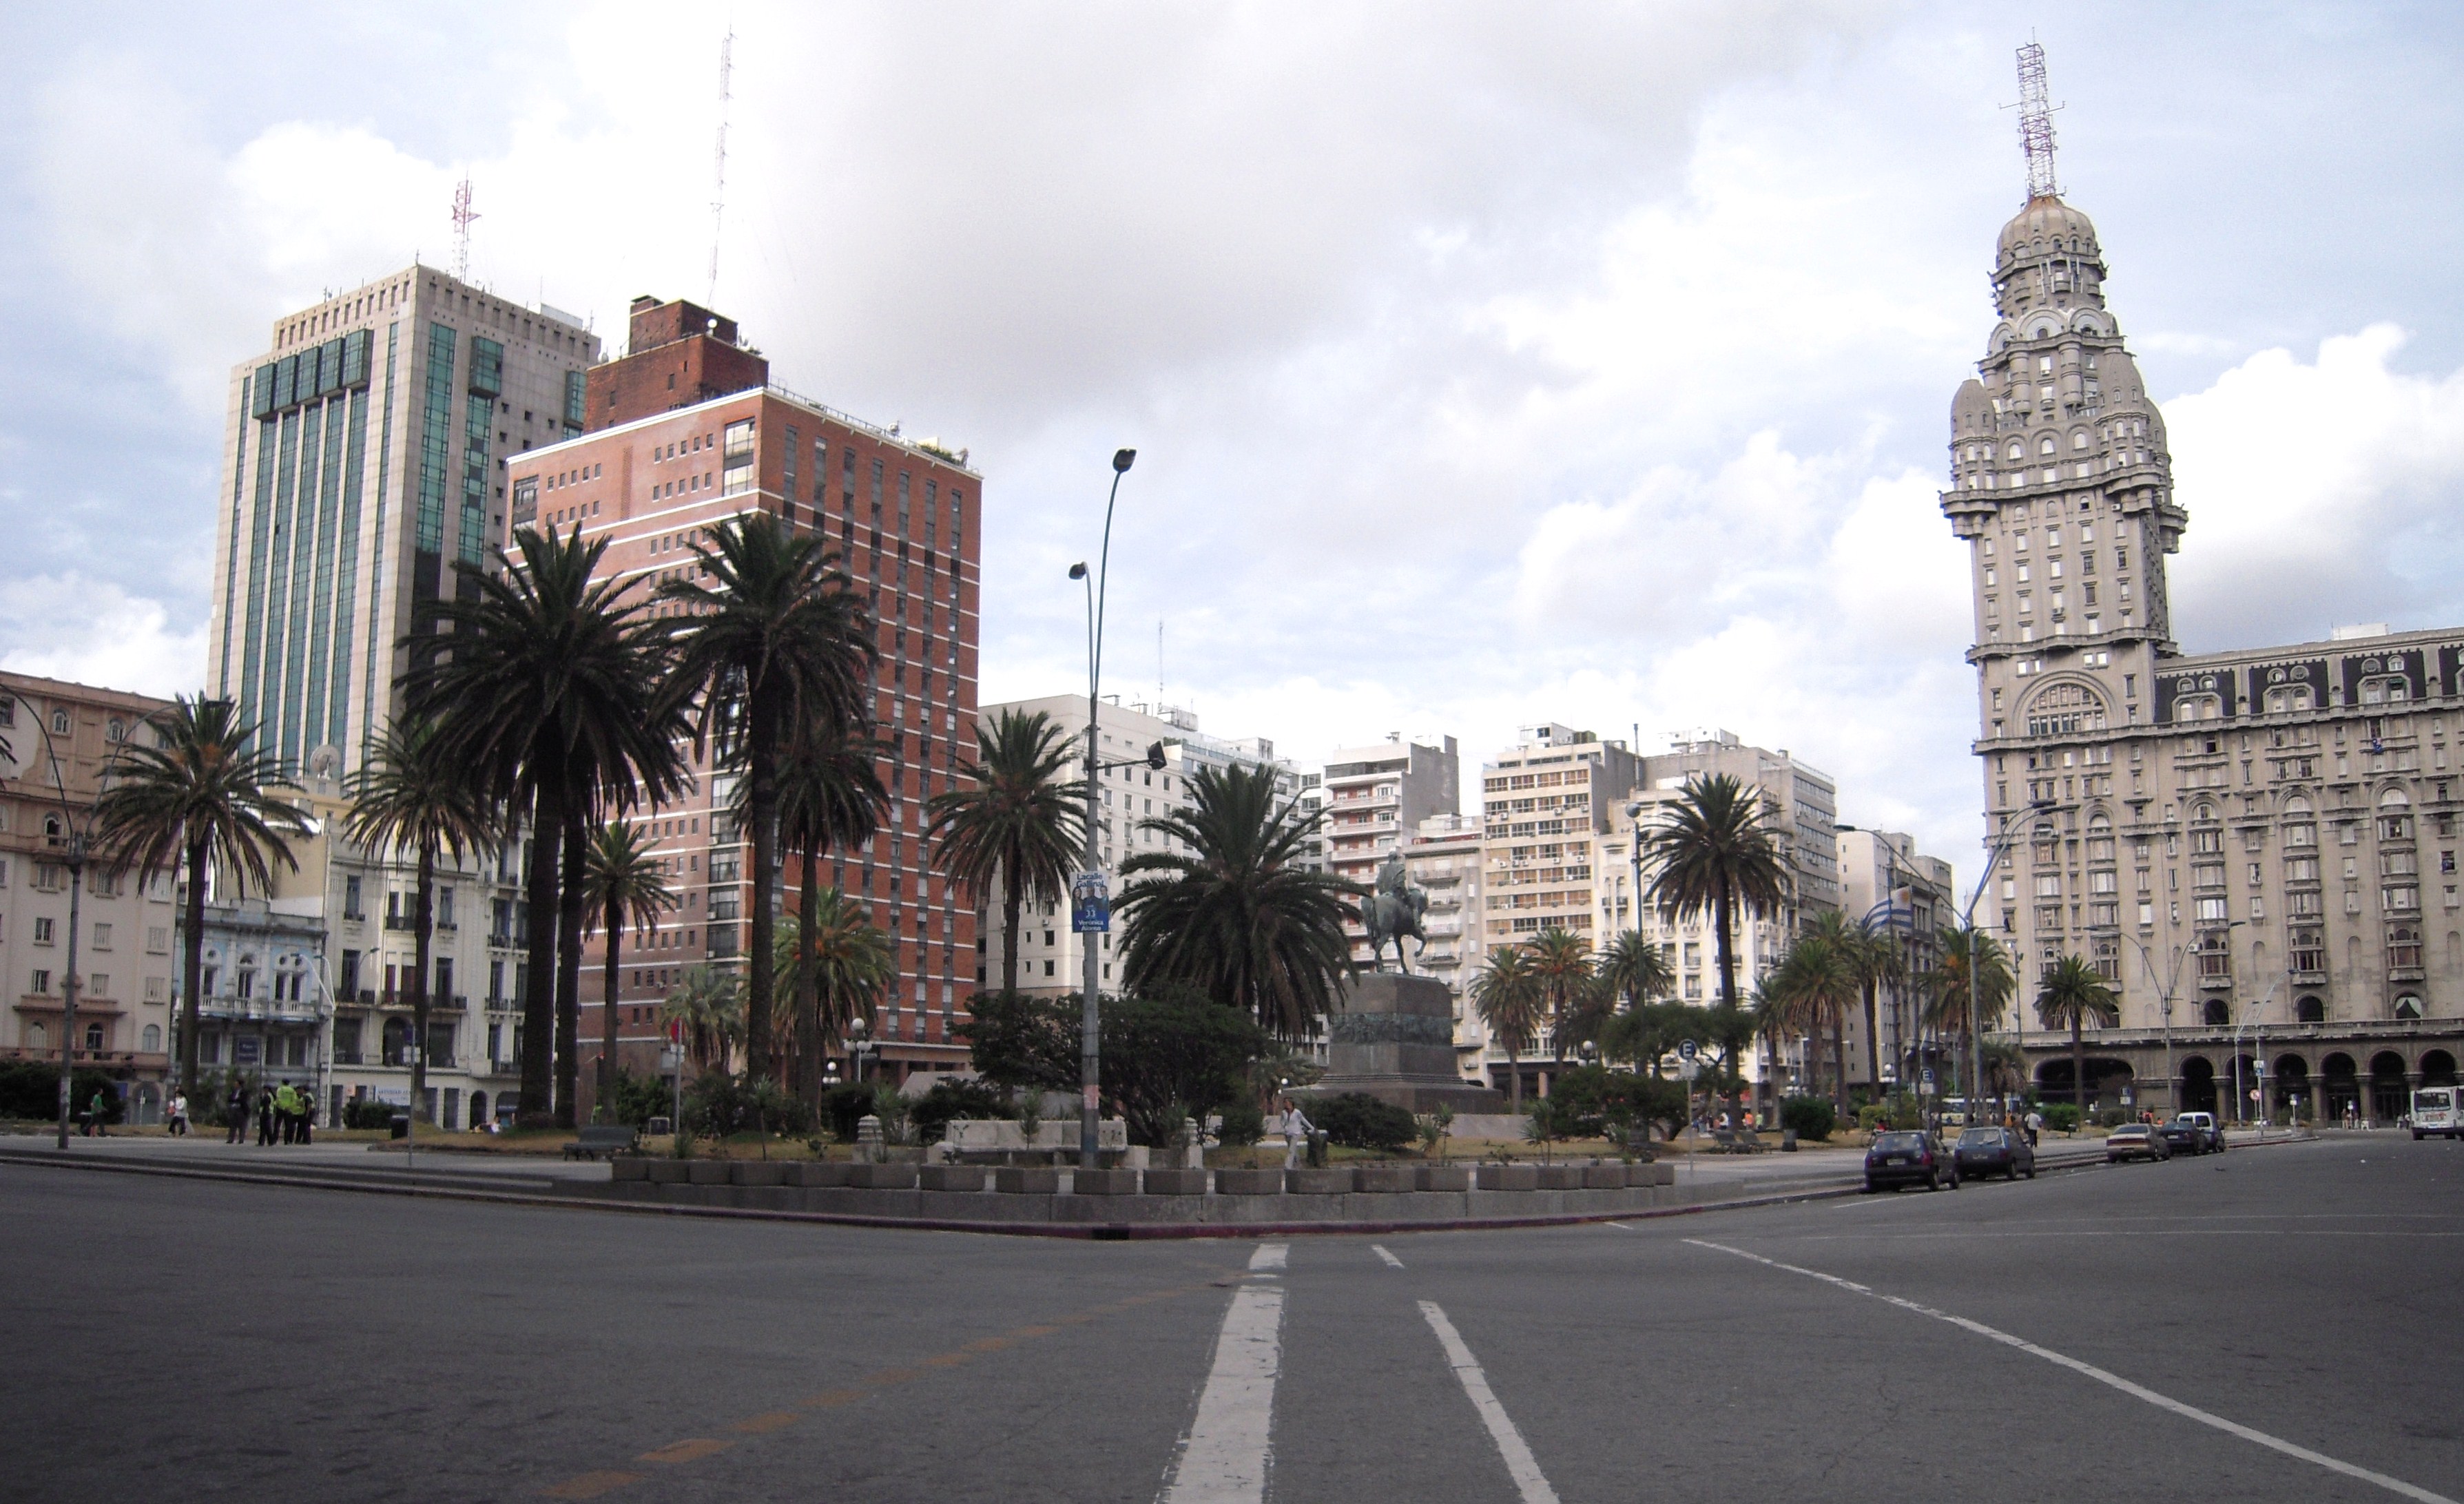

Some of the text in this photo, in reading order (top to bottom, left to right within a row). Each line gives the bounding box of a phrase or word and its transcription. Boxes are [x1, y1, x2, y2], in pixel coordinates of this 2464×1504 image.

[1085, 910, 1096, 918] 33
[1683, 1043, 1692, 1056] E
[1923, 1070, 1929, 1080] E
